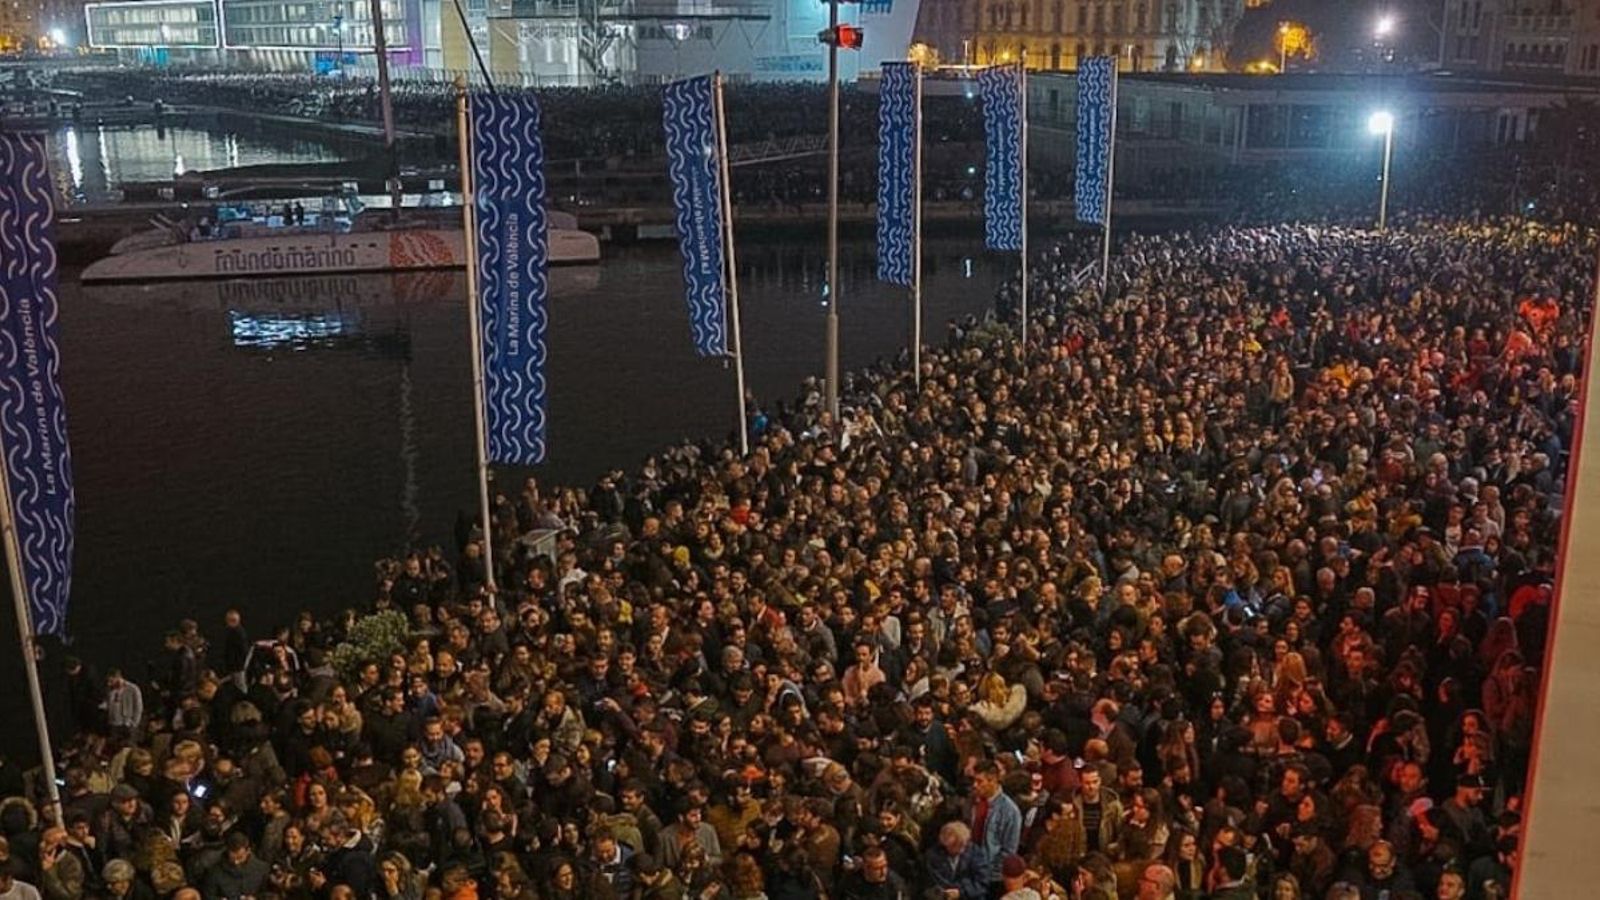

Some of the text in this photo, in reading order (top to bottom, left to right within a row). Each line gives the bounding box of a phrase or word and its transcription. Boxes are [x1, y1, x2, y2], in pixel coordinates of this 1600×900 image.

[215, 246, 356, 272] mundomarino
[506, 272, 520, 290] de
[507, 291, 520, 339] Marina
[507, 340, 519, 356] La
[31, 380, 44, 402] de
[36, 406, 53, 471] Marina
[46, 474, 56, 495] La
